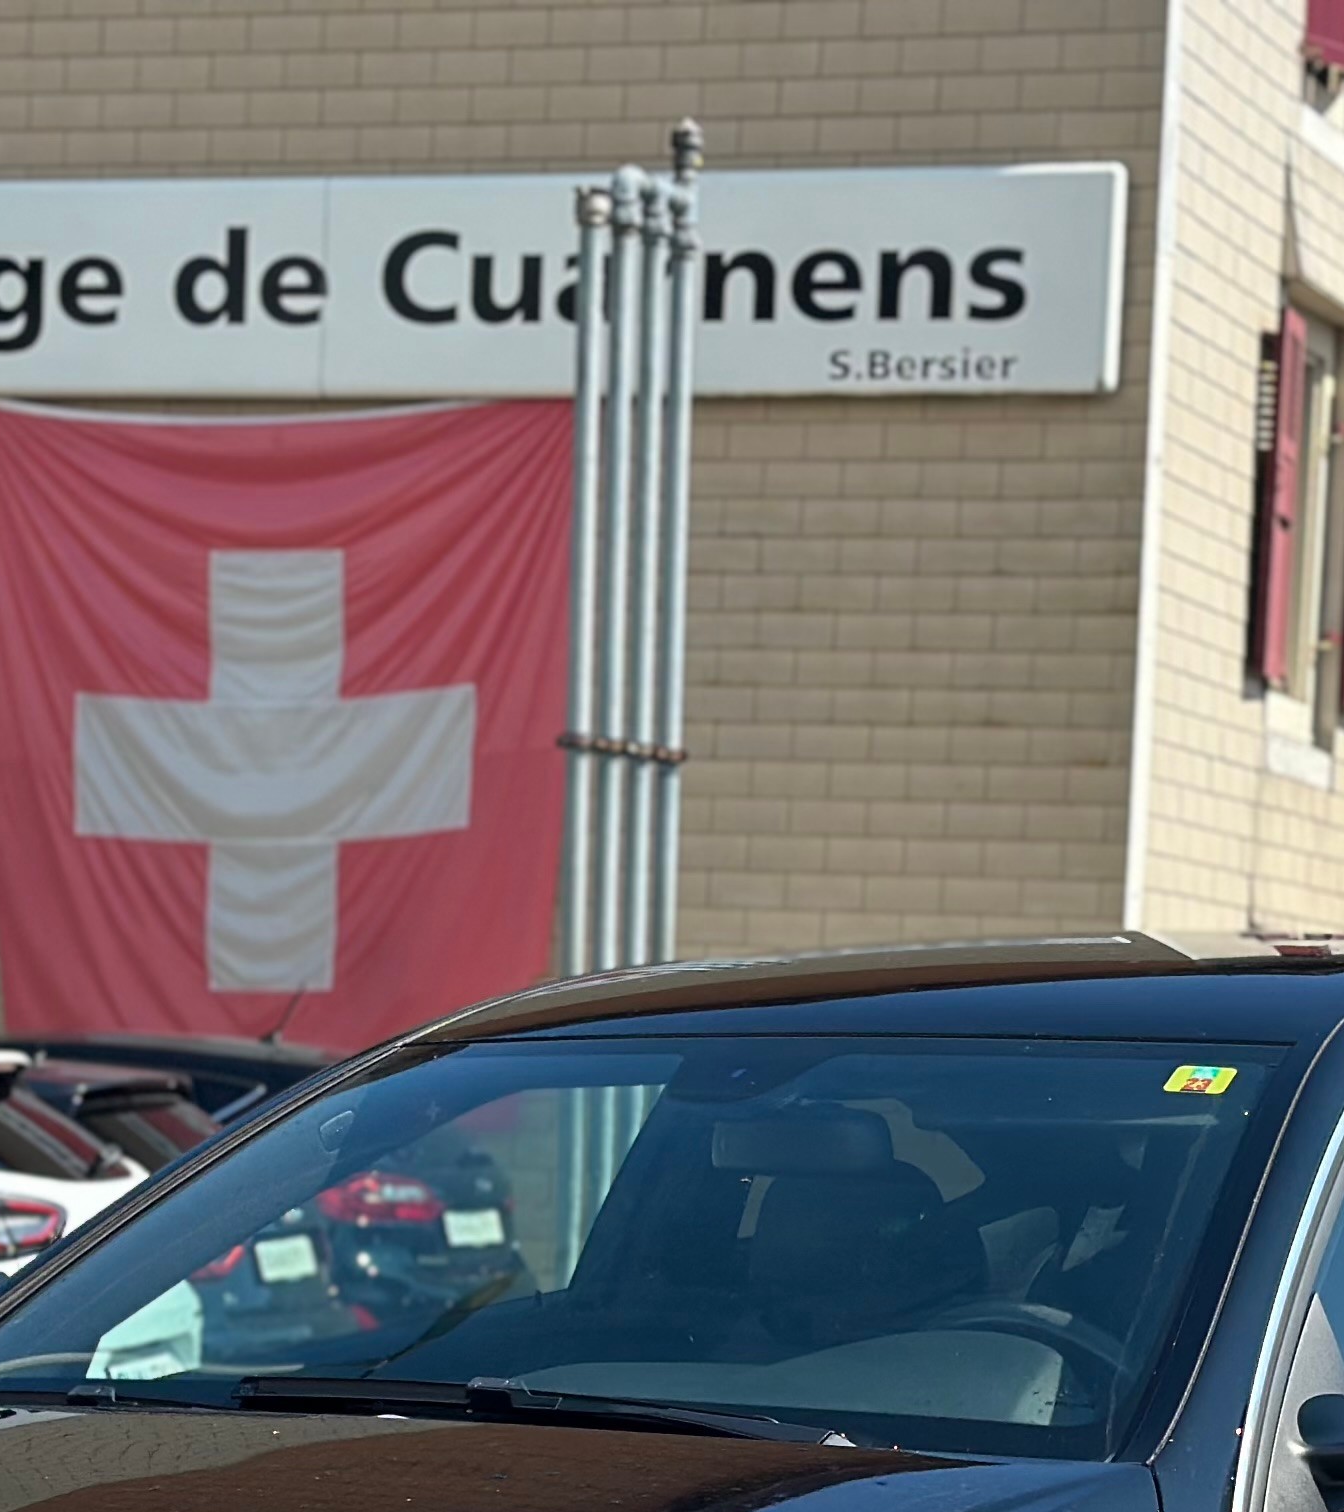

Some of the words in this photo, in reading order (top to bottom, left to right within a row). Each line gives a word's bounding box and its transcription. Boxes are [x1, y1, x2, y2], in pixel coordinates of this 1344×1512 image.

[175, 227, 329, 326] de
[381, 228, 1027, 324] Cuanens
[828, 347, 1018, 381] S.Bersier
